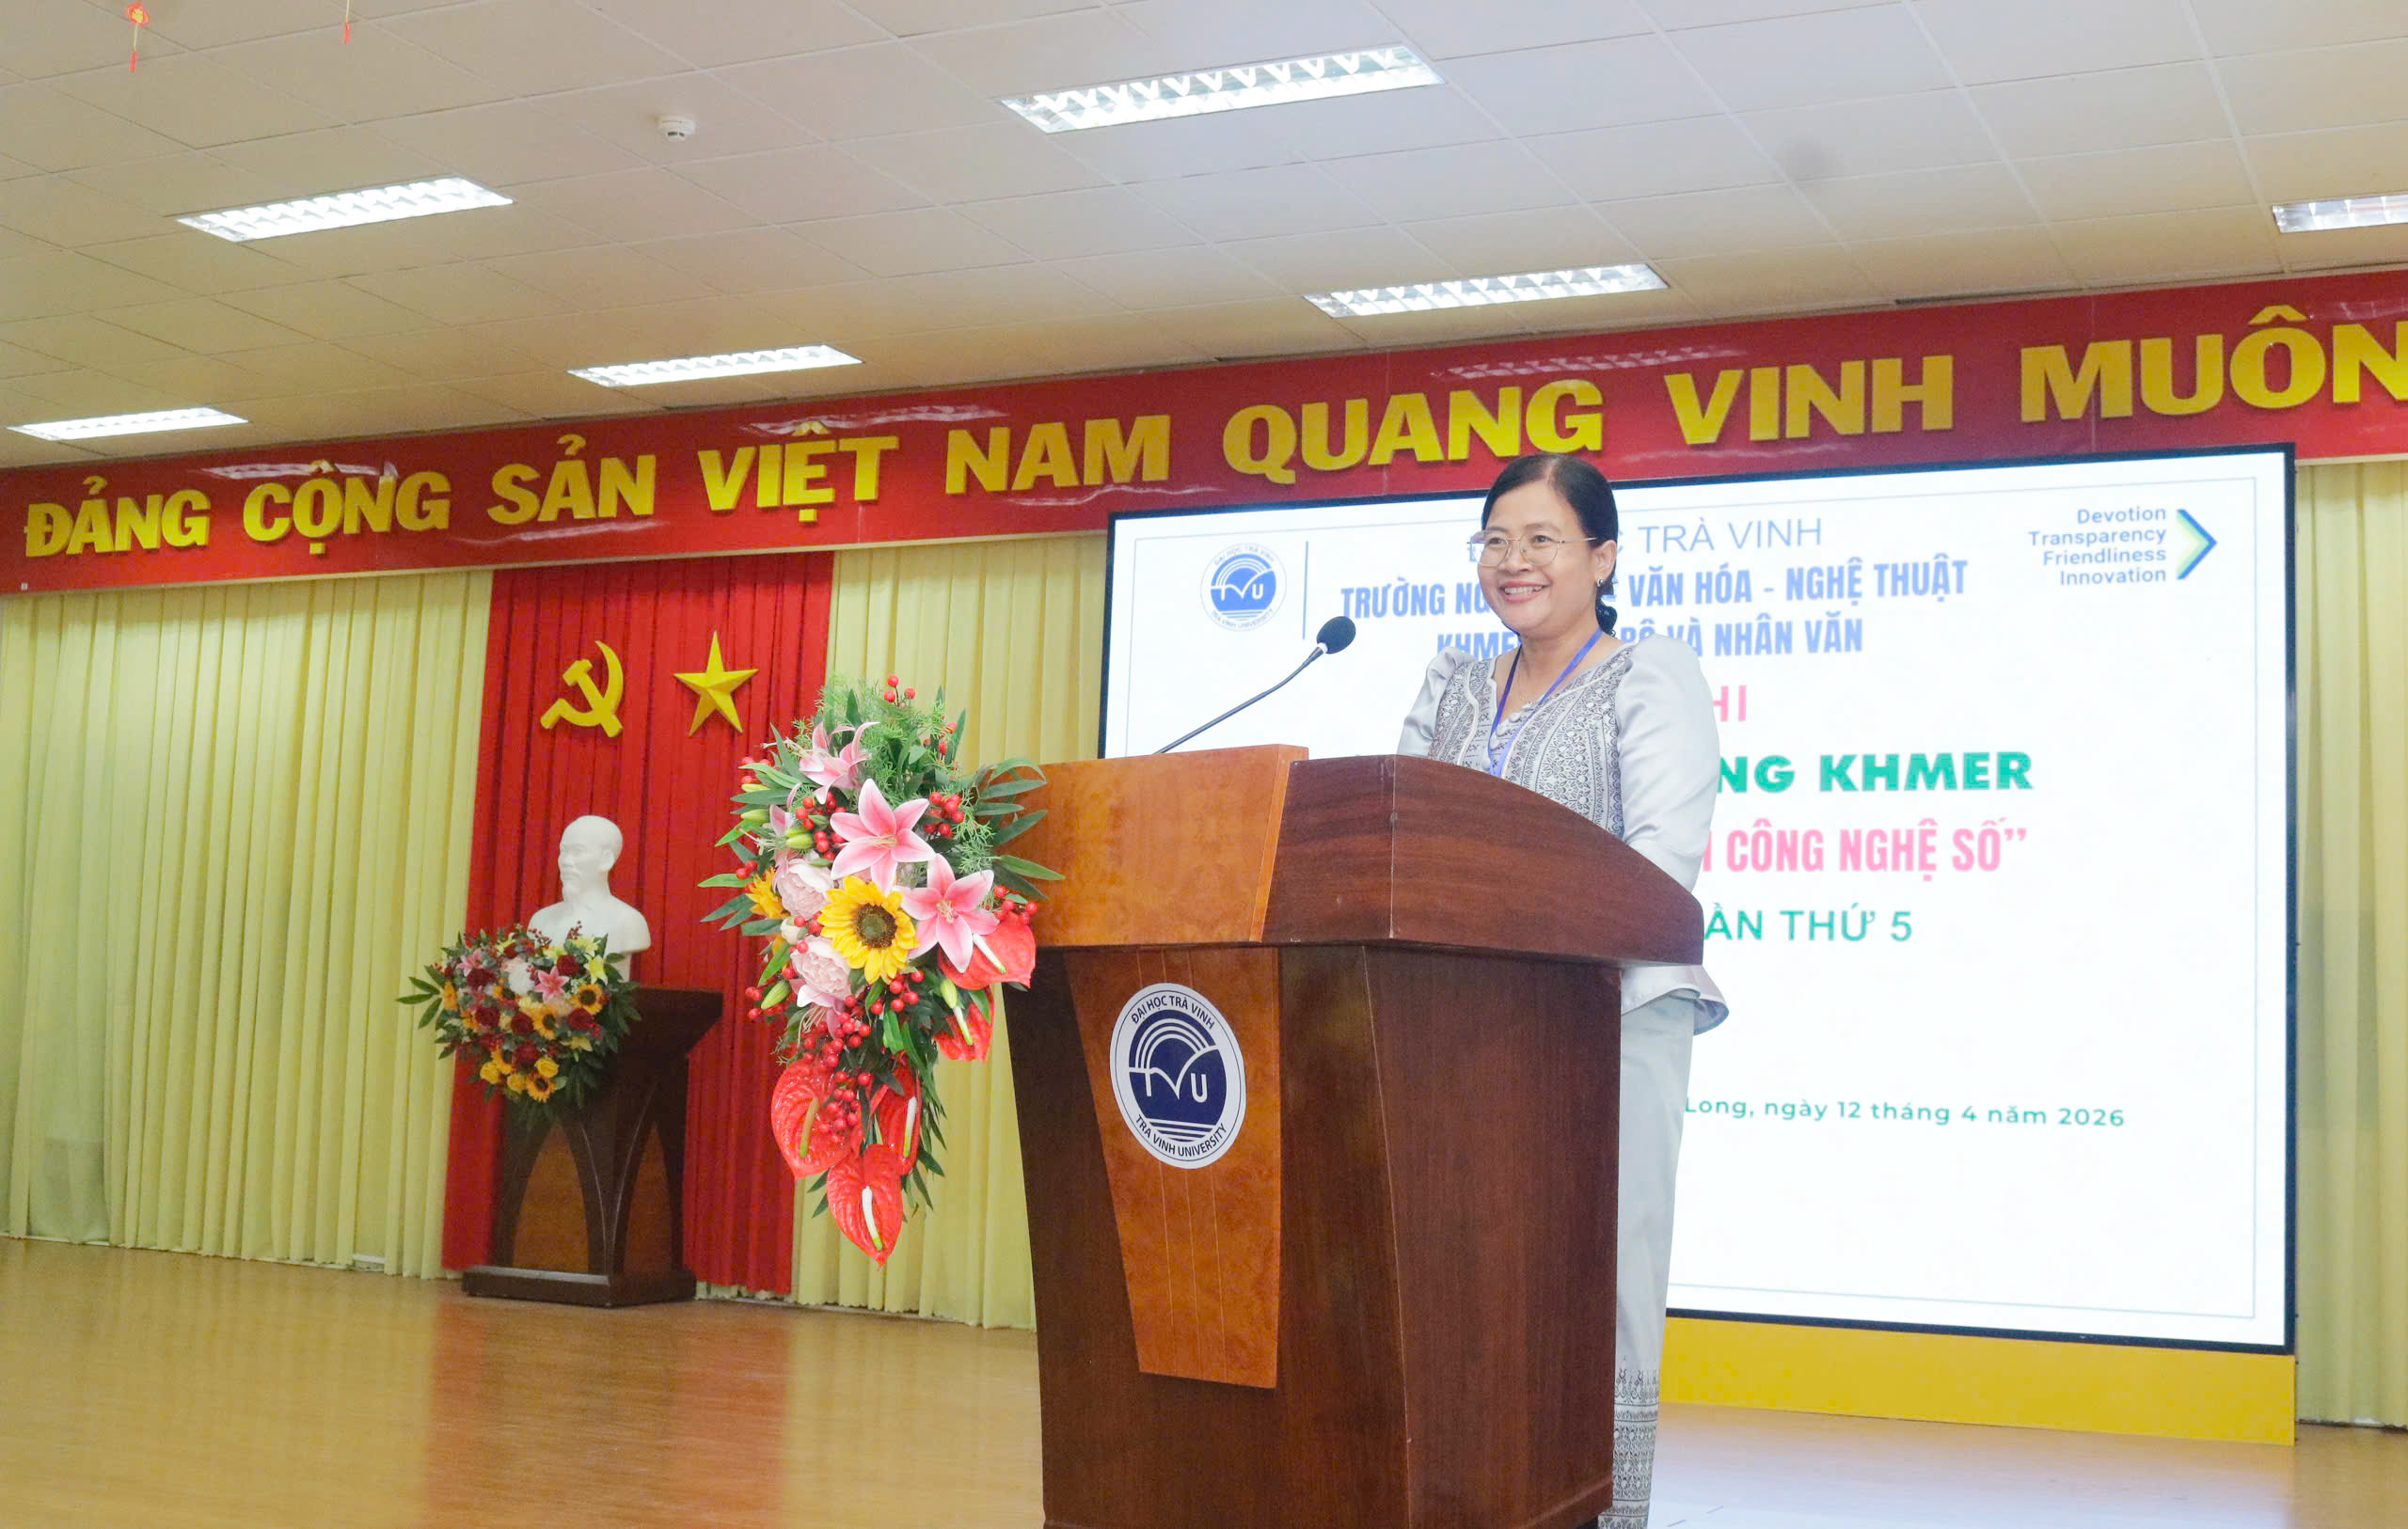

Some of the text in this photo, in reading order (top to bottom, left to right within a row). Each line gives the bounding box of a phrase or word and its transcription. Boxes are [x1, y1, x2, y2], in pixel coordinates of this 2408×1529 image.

[24, 305, 2408, 558] ĐẢNG CỘNG SẢN VIỆT NAM QUANG VINH MUÔN
[1639, 516, 1715, 553] TRÀ
[1728, 518, 1822, 549] VINH
[2077, 506, 2166, 525] Devotion
[2029, 529, 2166, 548] Transparency
[2043, 548, 2166, 566] Friendliness
[1340, 576, 1445, 620] TRƯỜNG
[1628, 565, 1684, 607] VĂN
[1695, 562, 1752, 605] HÓA
[1786, 557, 1862, 607] NGHỆ
[1874, 552, 1969, 603] THUẬT
[2061, 567, 2166, 586] Innovation
[1716, 612, 1793, 656] NHÂN
[1806, 610, 1862, 654] VĂN
[1819, 750, 2034, 793] KHMER
[1727, 818, 1824, 873] CÔNG
[1840, 817, 1938, 882] NGHỆ
[1779, 902, 1876, 941] THỨ
[1891, 910, 1912, 941] 5
[1132, 995, 1215, 1030] ĐẠI HỌC TRÀ VINH
[1765, 1100, 1828, 1122] ngày
[1838, 1101, 1861, 1118] 12
[1871, 1102, 1950, 1126] tháng
[1961, 1105, 1977, 1121] 4
[1988, 1105, 2048, 1124] năm
[2059, 1107, 2125, 1127] 2026
[1135, 1116, 1228, 1157] TRA VINH UNIVERSITY
